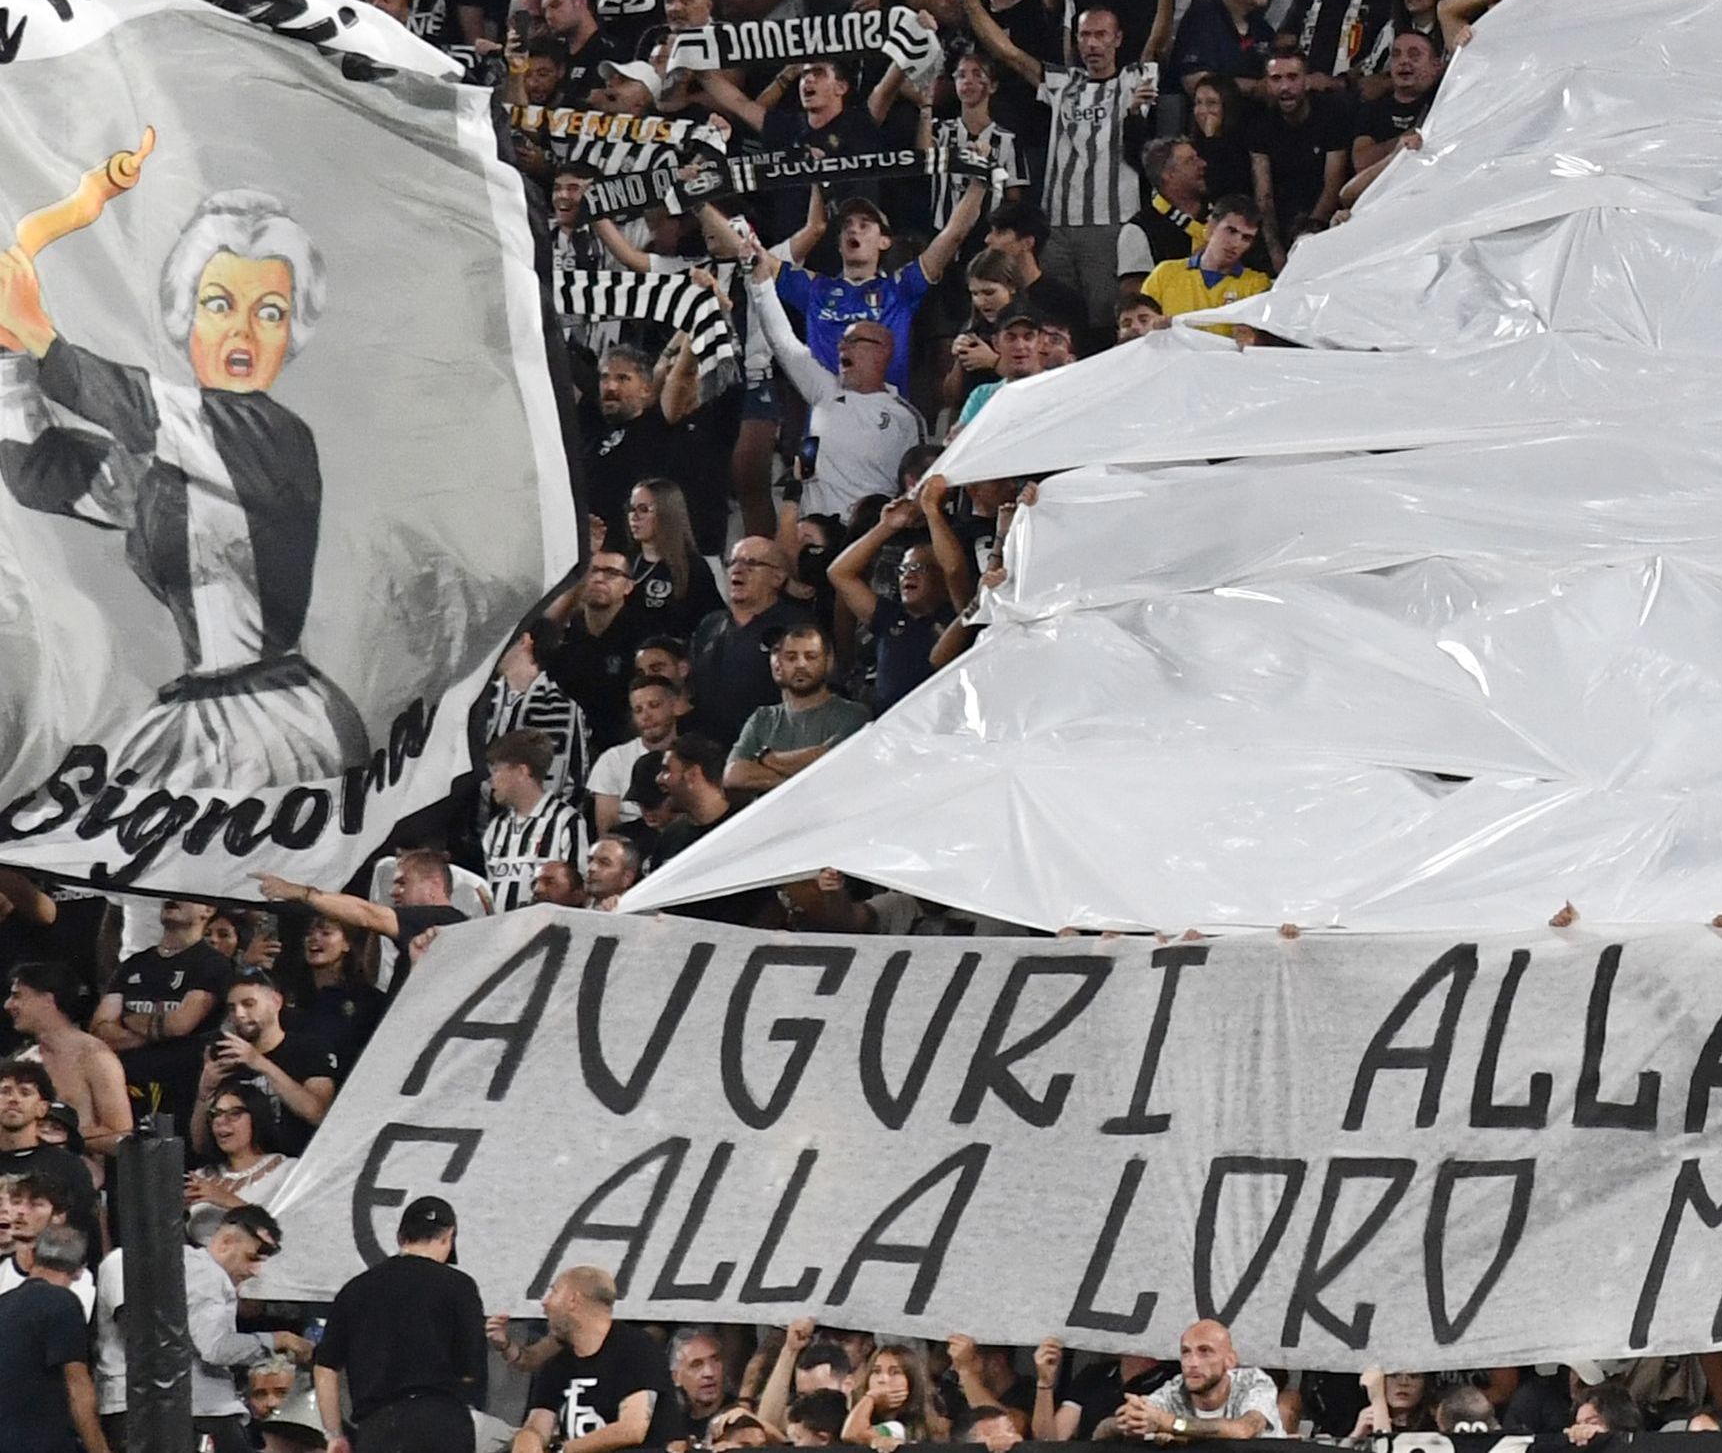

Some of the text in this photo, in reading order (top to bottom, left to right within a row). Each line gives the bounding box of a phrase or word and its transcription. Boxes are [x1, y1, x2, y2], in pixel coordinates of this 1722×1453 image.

[510, 103, 673, 142] JUVENTUS
[764, 149, 916, 179] JUVENTUS
[398, 925, 1209, 1135] AUGURI
[525, 1135, 992, 1317] ALLA
[1066, 1156, 1537, 1349] LORO
